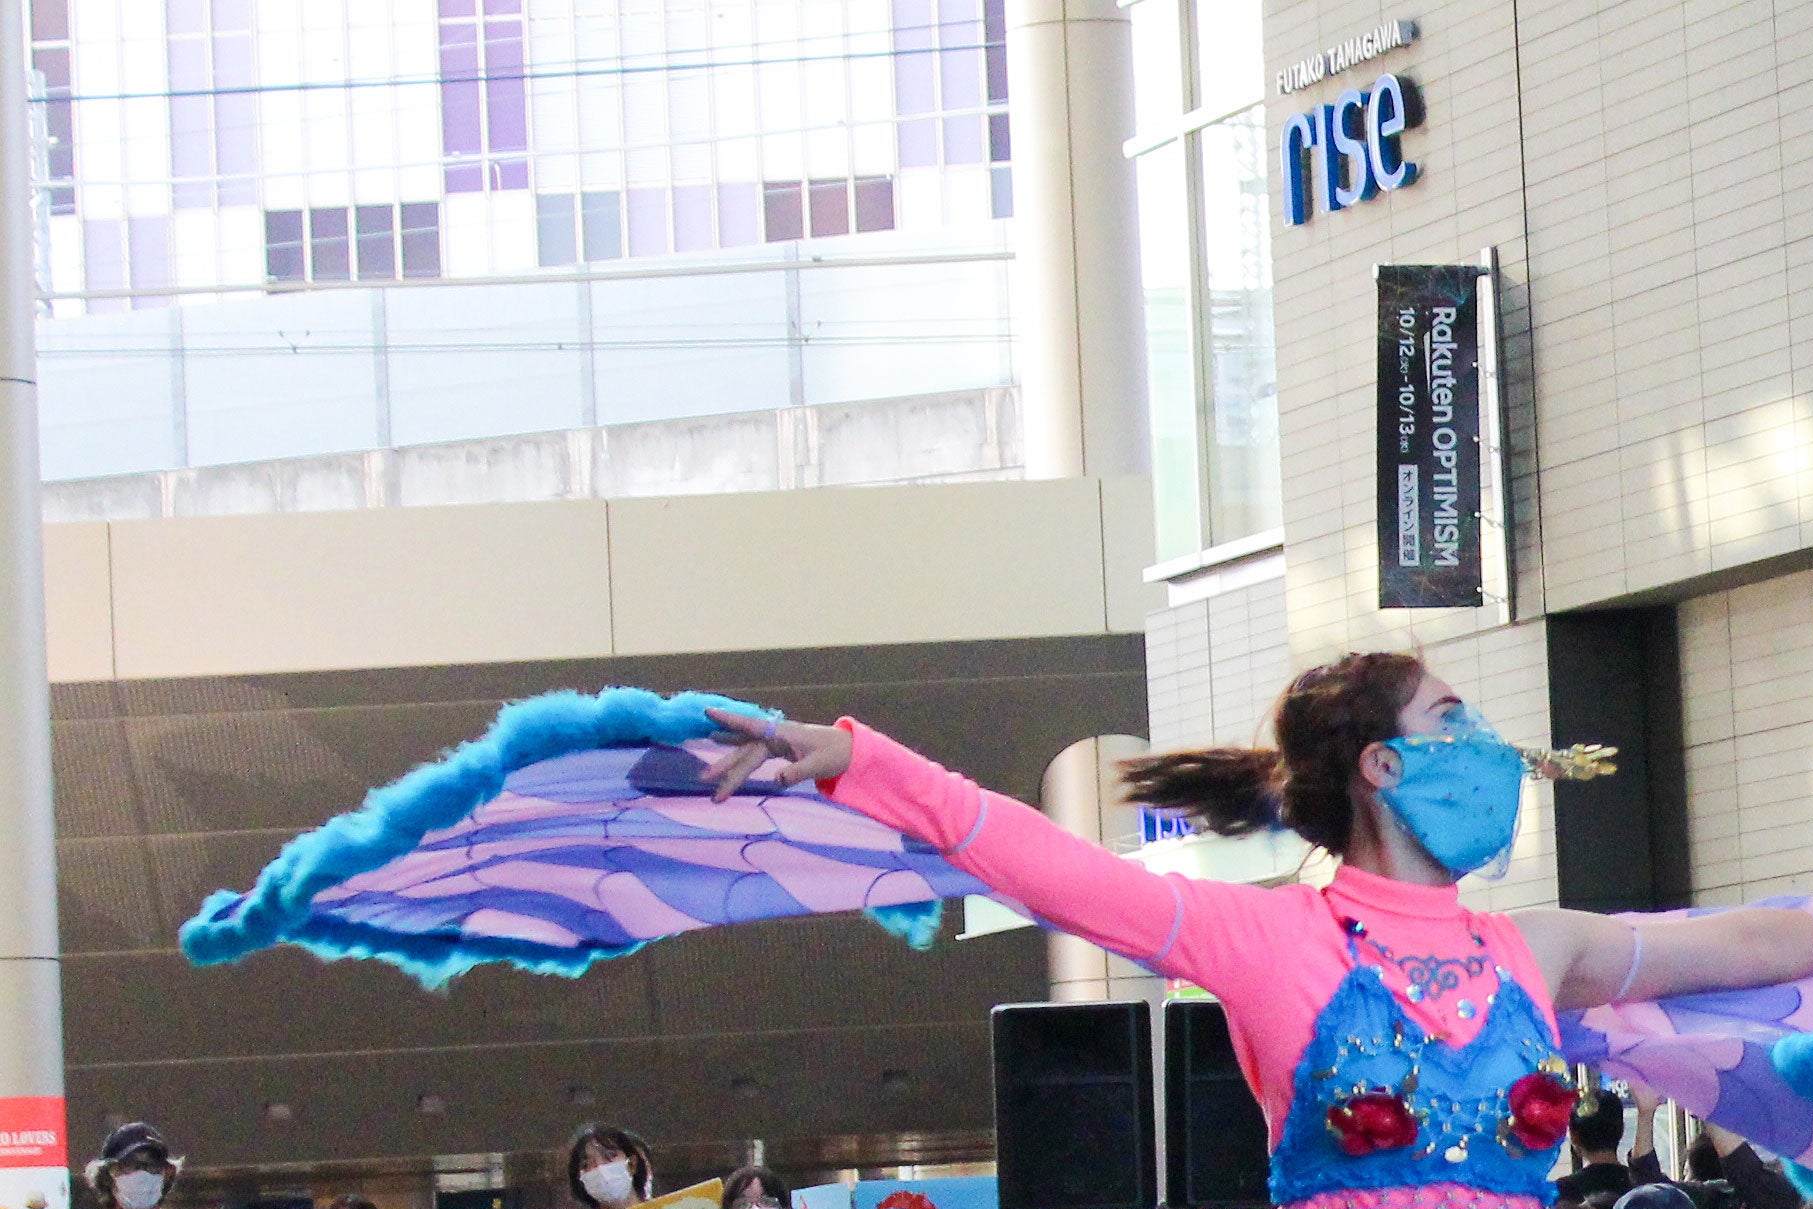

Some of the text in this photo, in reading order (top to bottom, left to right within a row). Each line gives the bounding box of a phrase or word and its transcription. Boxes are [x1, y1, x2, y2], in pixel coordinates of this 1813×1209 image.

[1277, 19, 1404, 96] FUTAKO TAMAGAWA
[1280, 73, 1410, 227] rise
[1430, 307, 1460, 567] Rakuten OPTIMISM
